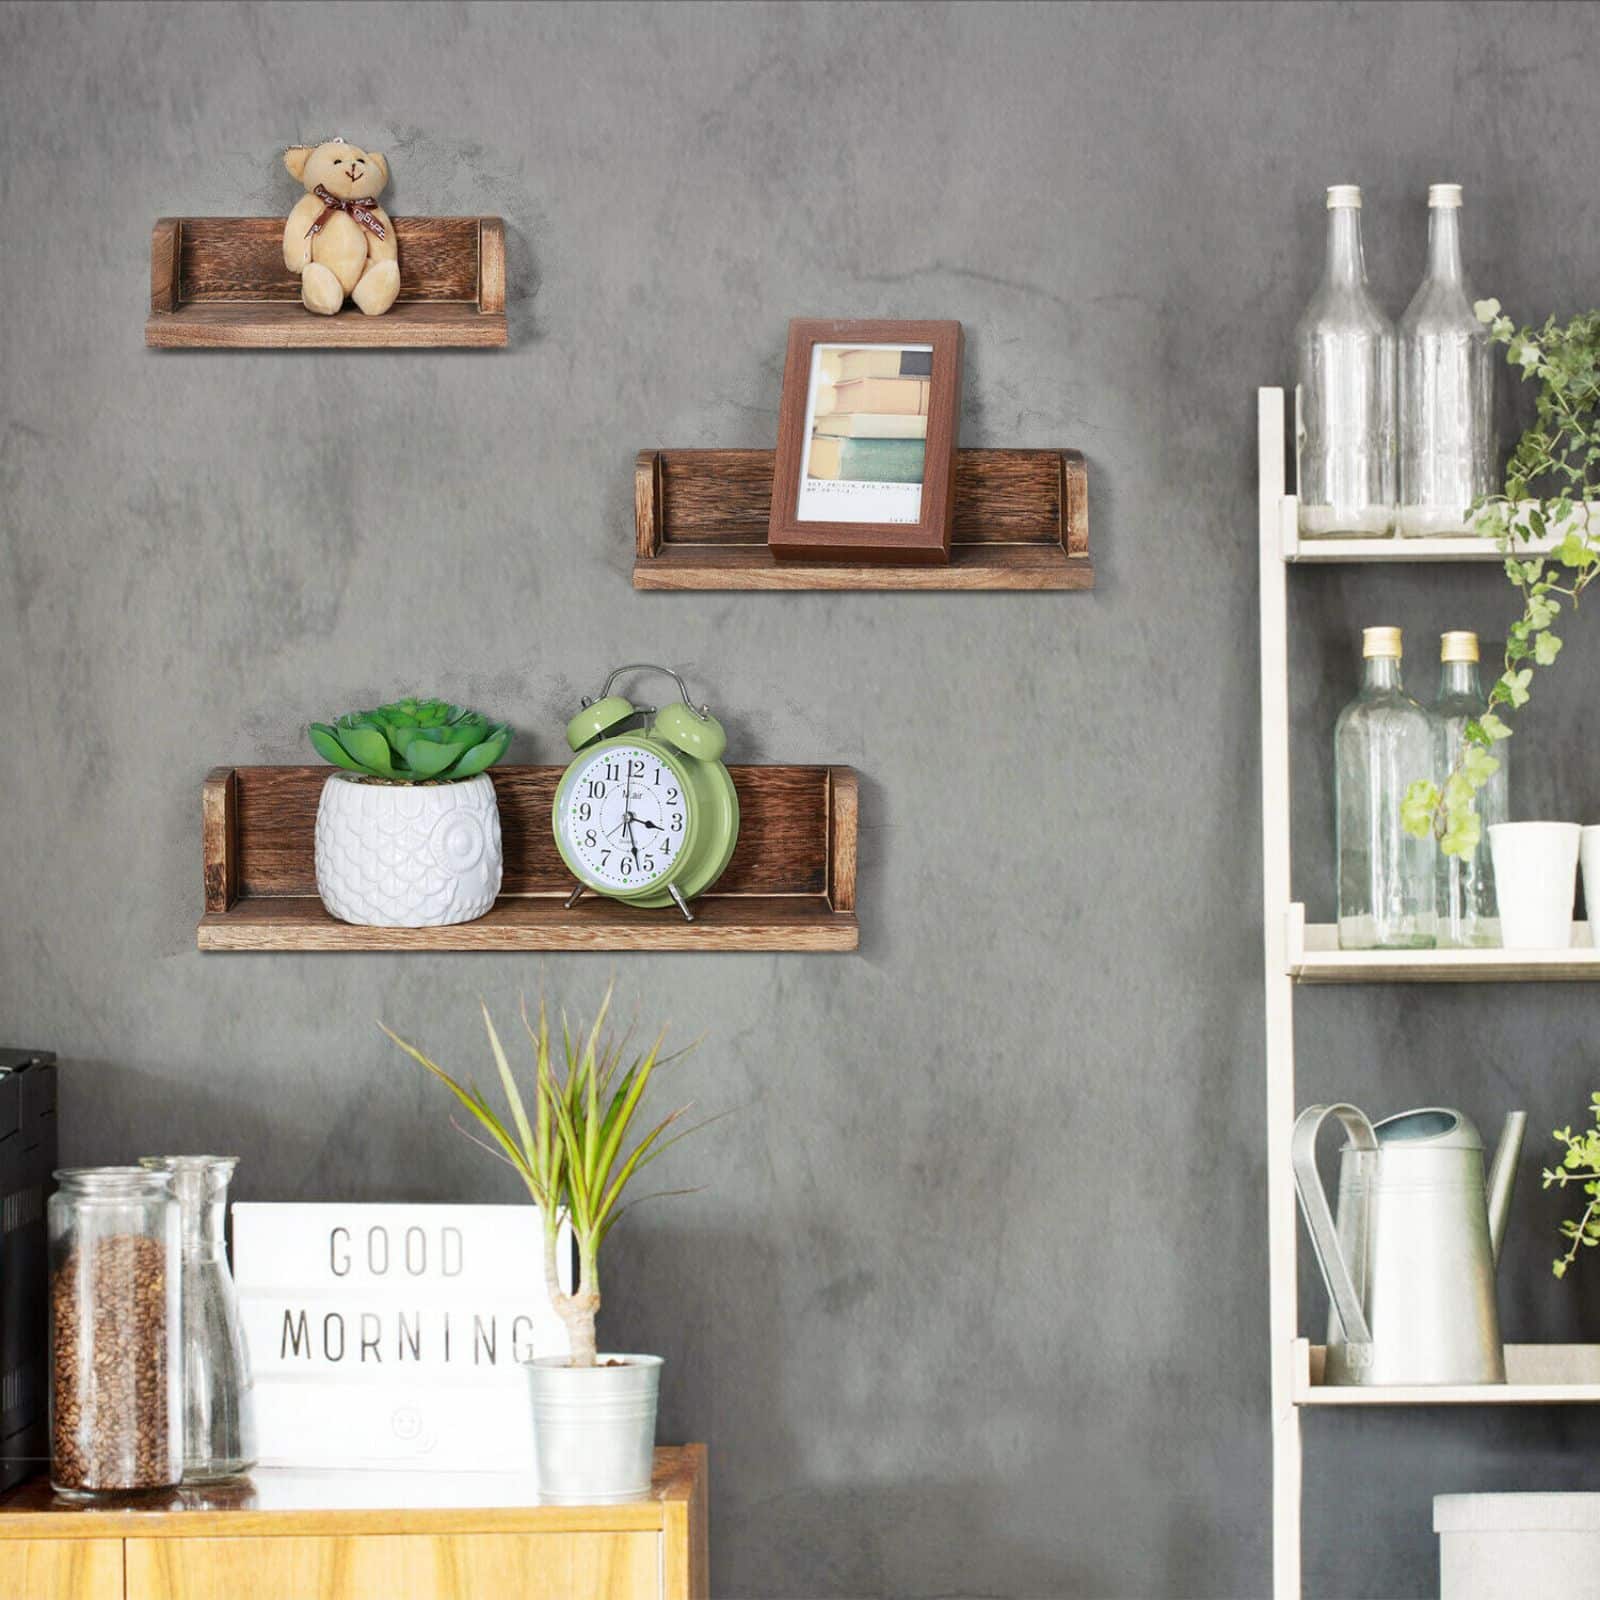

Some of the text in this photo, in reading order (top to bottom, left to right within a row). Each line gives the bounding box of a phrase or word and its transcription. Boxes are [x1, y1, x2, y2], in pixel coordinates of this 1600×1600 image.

[606, 764, 620, 782] 11
[654, 768, 661, 786] 1
[588, 781, 606, 799] 10
[666, 788, 678, 805] 2
[579, 803, 591, 822] 9
[671, 813, 683, 832] 3
[584, 829, 597, 847] 8
[660, 837, 671, 855] 4
[601, 849, 611, 867] 7
[620, 856, 632, 875] 6
[643, 854, 654, 872] 5
[330, 1225, 463, 1277] GOOD
[280, 1309, 534, 1365] MORNING
